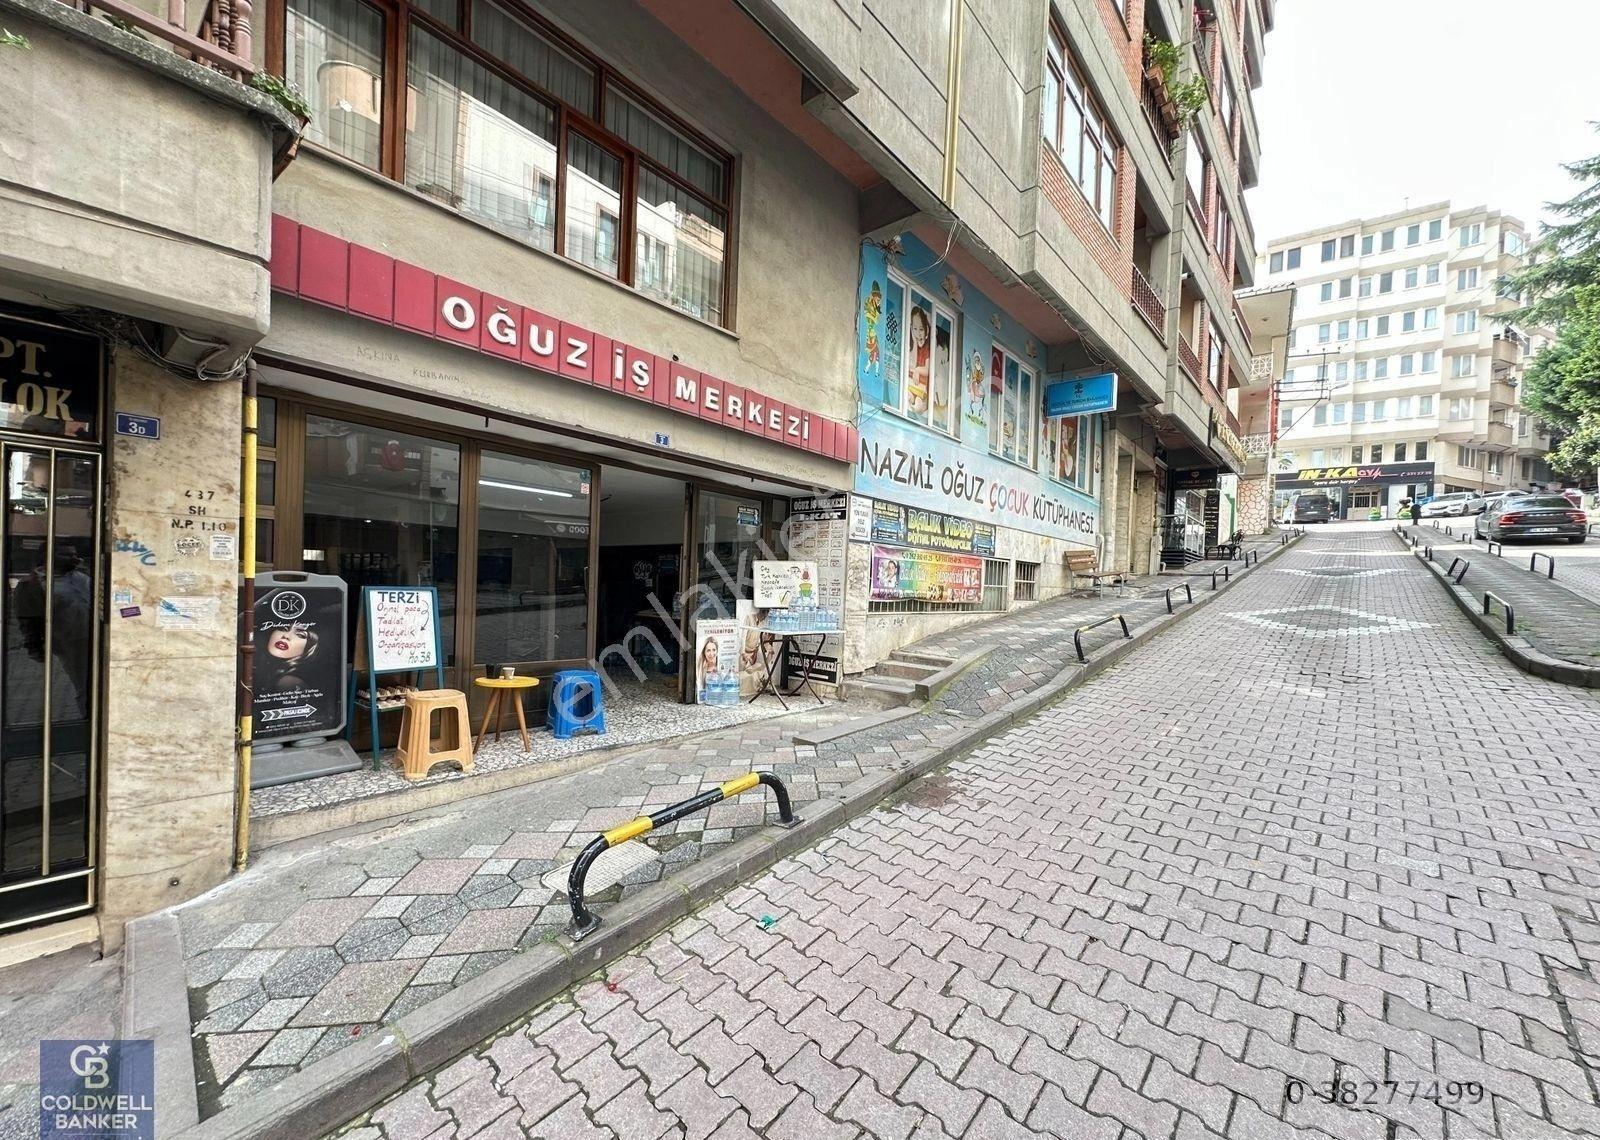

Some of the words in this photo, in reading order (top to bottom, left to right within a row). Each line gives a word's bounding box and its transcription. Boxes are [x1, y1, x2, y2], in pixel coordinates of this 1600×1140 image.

[441, 295, 587, 368] OĞUZ
[614, 347, 650, 393] İŞ
[674, 375, 810, 440] MERKEZİ
[128, 421, 146, 435] 3D
[860, 437, 934, 490] NAZMİ
[941, 460, 985, 504] OĞUZ
[989, 482, 1029, 517] ÇOCUK
[1032, 493, 1095, 534] KÜTÜPHANESİ
[188, 505, 206, 516] SH
[907, 509, 942, 534] BALIK
[943, 515, 975, 539] VİDEO
[278, 599, 300, 611] DK
